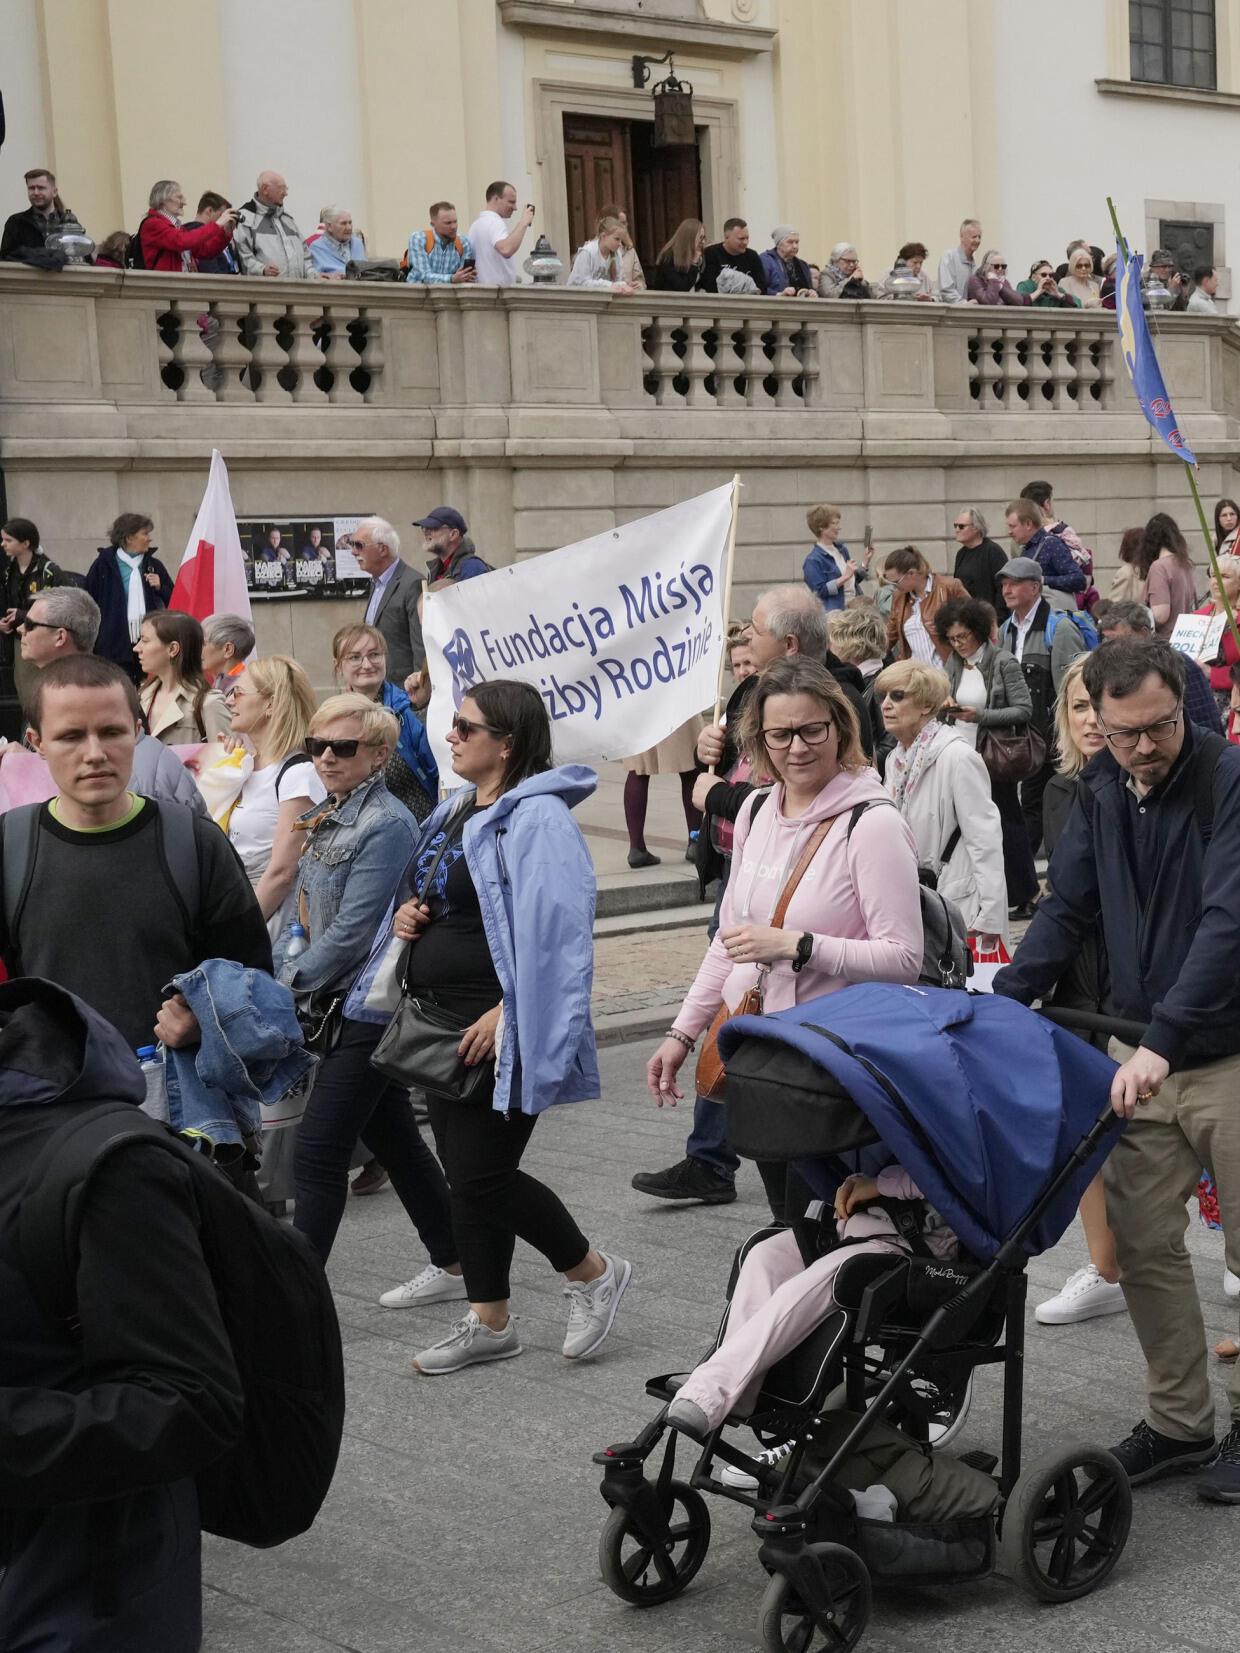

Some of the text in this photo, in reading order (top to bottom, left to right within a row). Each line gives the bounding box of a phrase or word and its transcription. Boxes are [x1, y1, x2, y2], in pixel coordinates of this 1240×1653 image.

[480, 561, 713, 671] Fundacja Misja
[540, 615, 713, 720] żby Rodzinie
